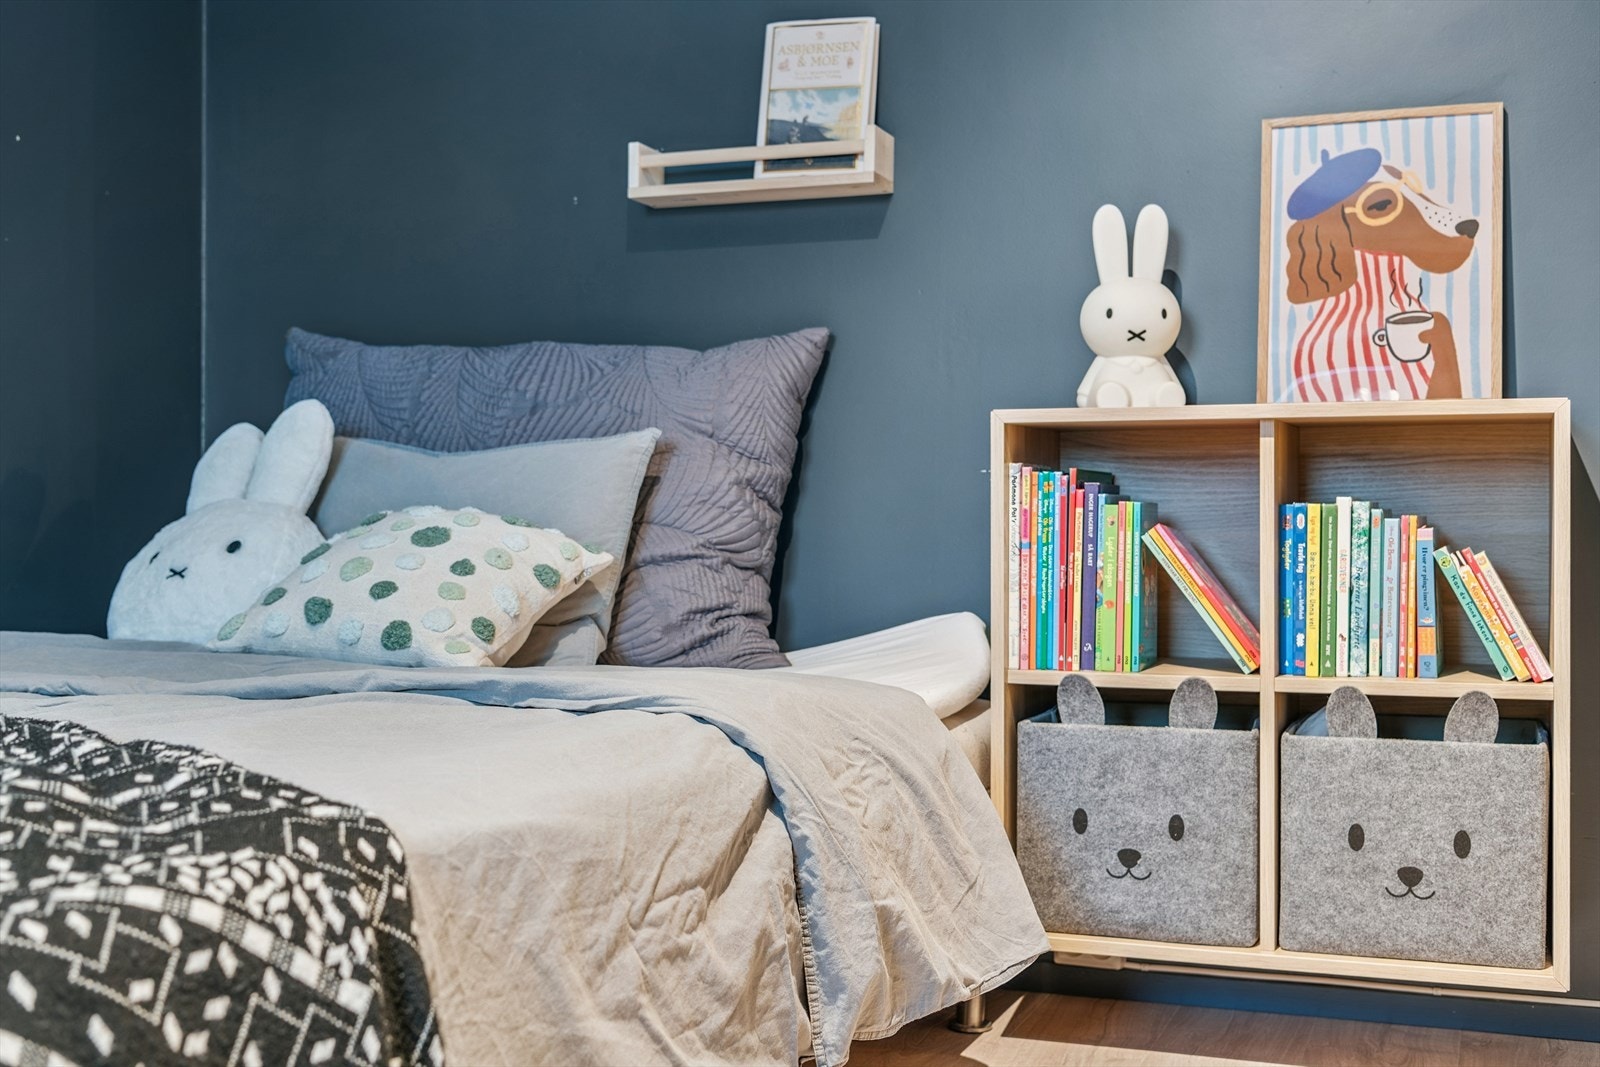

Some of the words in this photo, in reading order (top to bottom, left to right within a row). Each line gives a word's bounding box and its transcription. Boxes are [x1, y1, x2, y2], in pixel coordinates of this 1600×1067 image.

[778, 41, 860, 56] ASBJØRNSEN
[797, 56, 806, 67] &
[810, 55, 839, 67] MOE
[1105, 537, 1114, 557] Lyder
[1282, 538, 1292, 570] Toglyder
[1297, 543, 1305, 561] Travle
[1105, 563, 1114, 587] skogen
[1296, 563, 1305, 573] tog
[1422, 565, 1427, 573] er
[1421, 574, 1429, 611] pingvinen?
[1450, 573, 1462, 589] Kan
[1459, 591, 1466, 600] du
[1465, 600, 1479, 618] finne
[1475, 618, 1493, 644] lekene?
